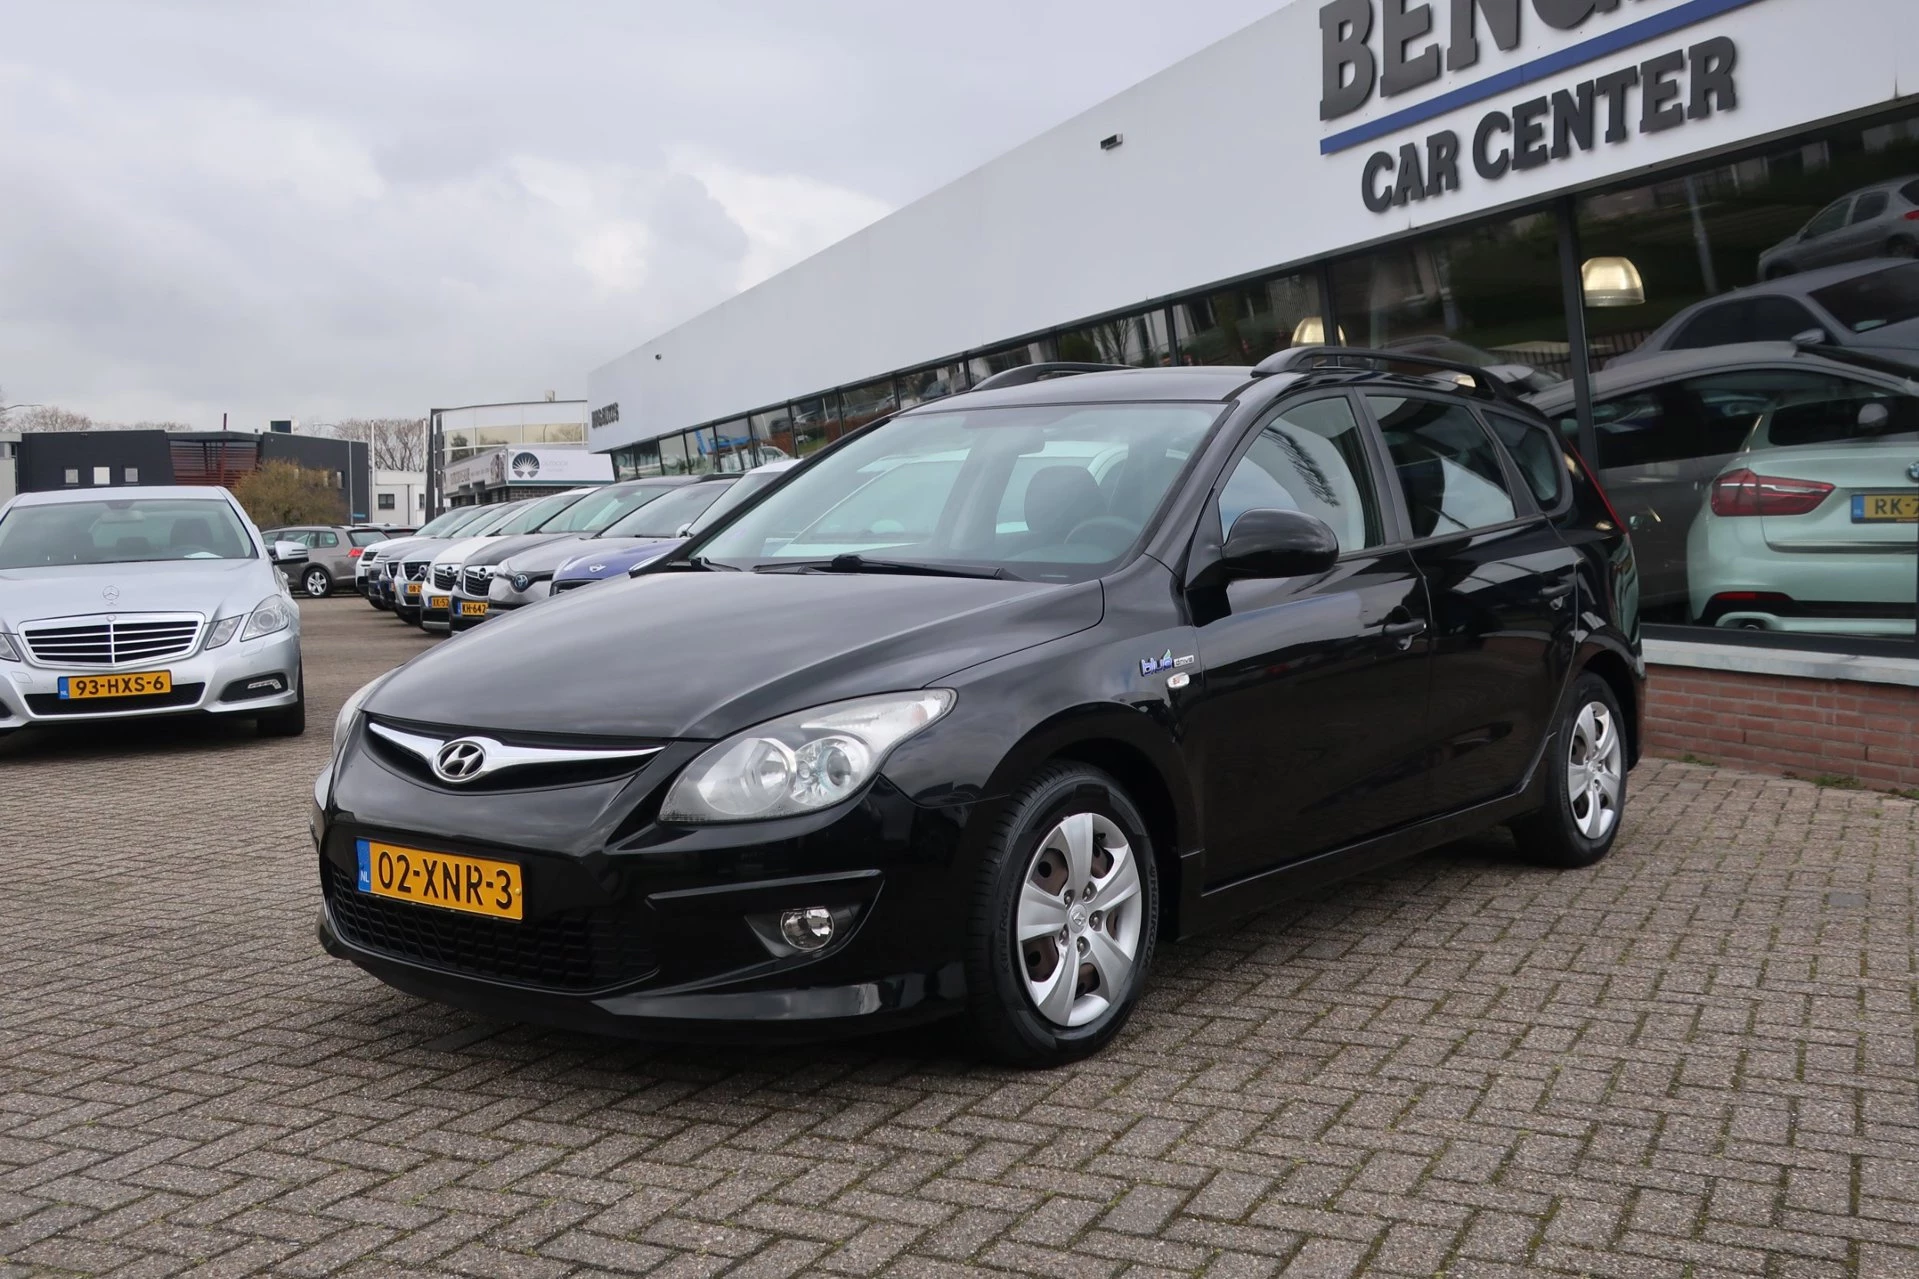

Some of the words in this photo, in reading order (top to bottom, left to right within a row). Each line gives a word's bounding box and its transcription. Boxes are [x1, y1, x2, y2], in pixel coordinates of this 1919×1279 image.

[1362, 129, 1460, 213] CAR
[1472, 36, 1738, 180] CENTER
[75, 675, 165, 696] 93-HXS-6
[360, 870, 370, 883] NL
[379, 851, 513, 909] 02-XNR-3
